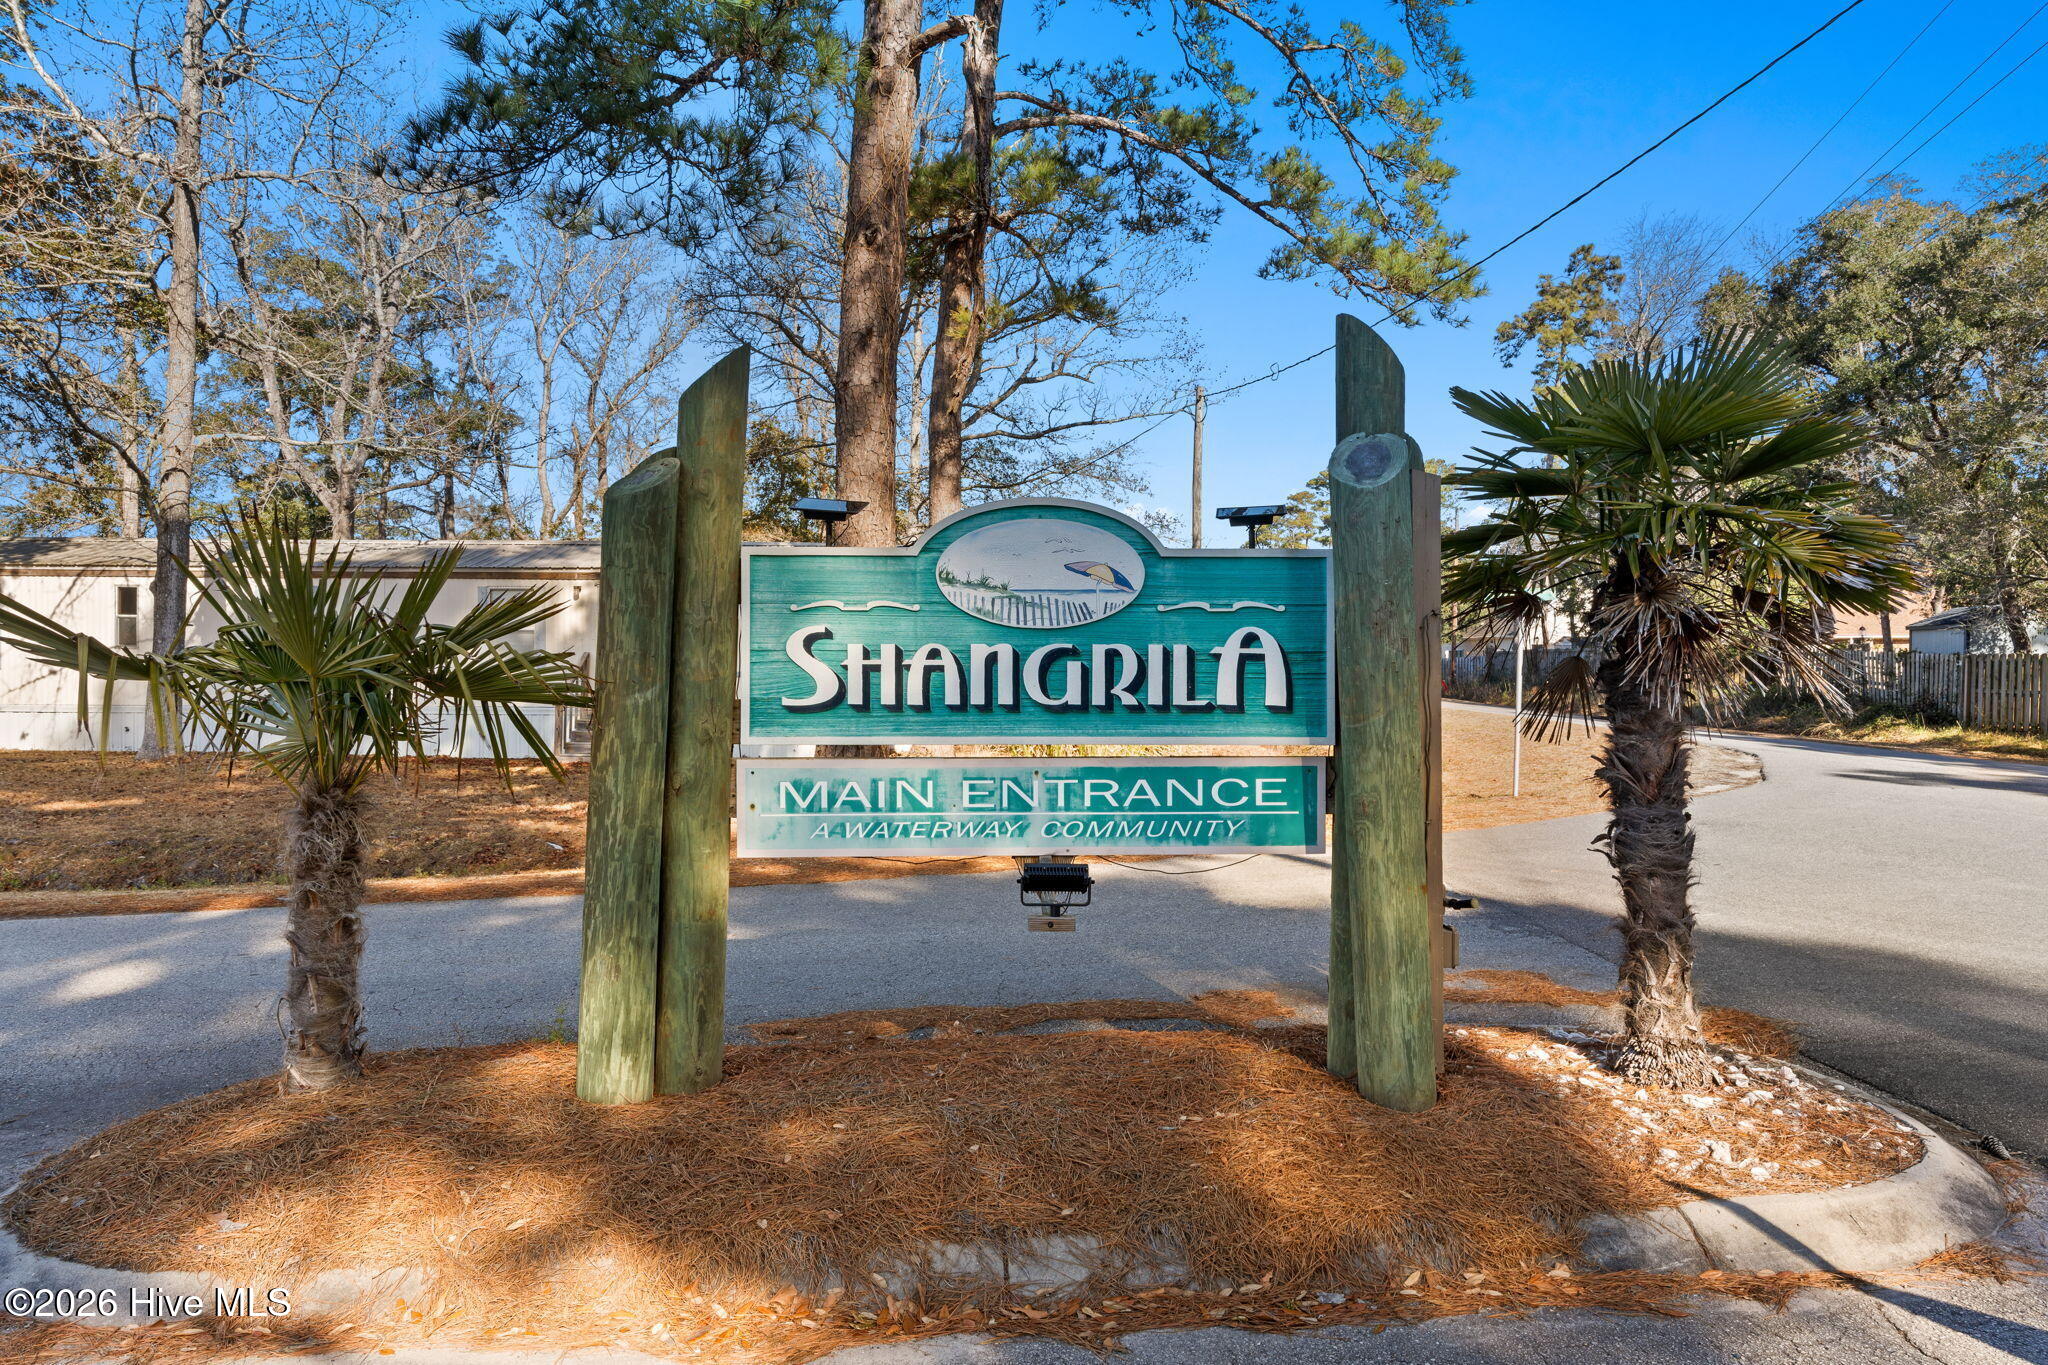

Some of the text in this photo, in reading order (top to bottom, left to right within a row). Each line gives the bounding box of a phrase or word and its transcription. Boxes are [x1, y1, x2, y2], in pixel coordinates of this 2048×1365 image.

[781, 625, 1293, 713] SHANGRILA
[778, 778, 1288, 809] MAIN ENTRANCE
[810, 819, 1246, 840] A WATERWAY COMMUNITY
